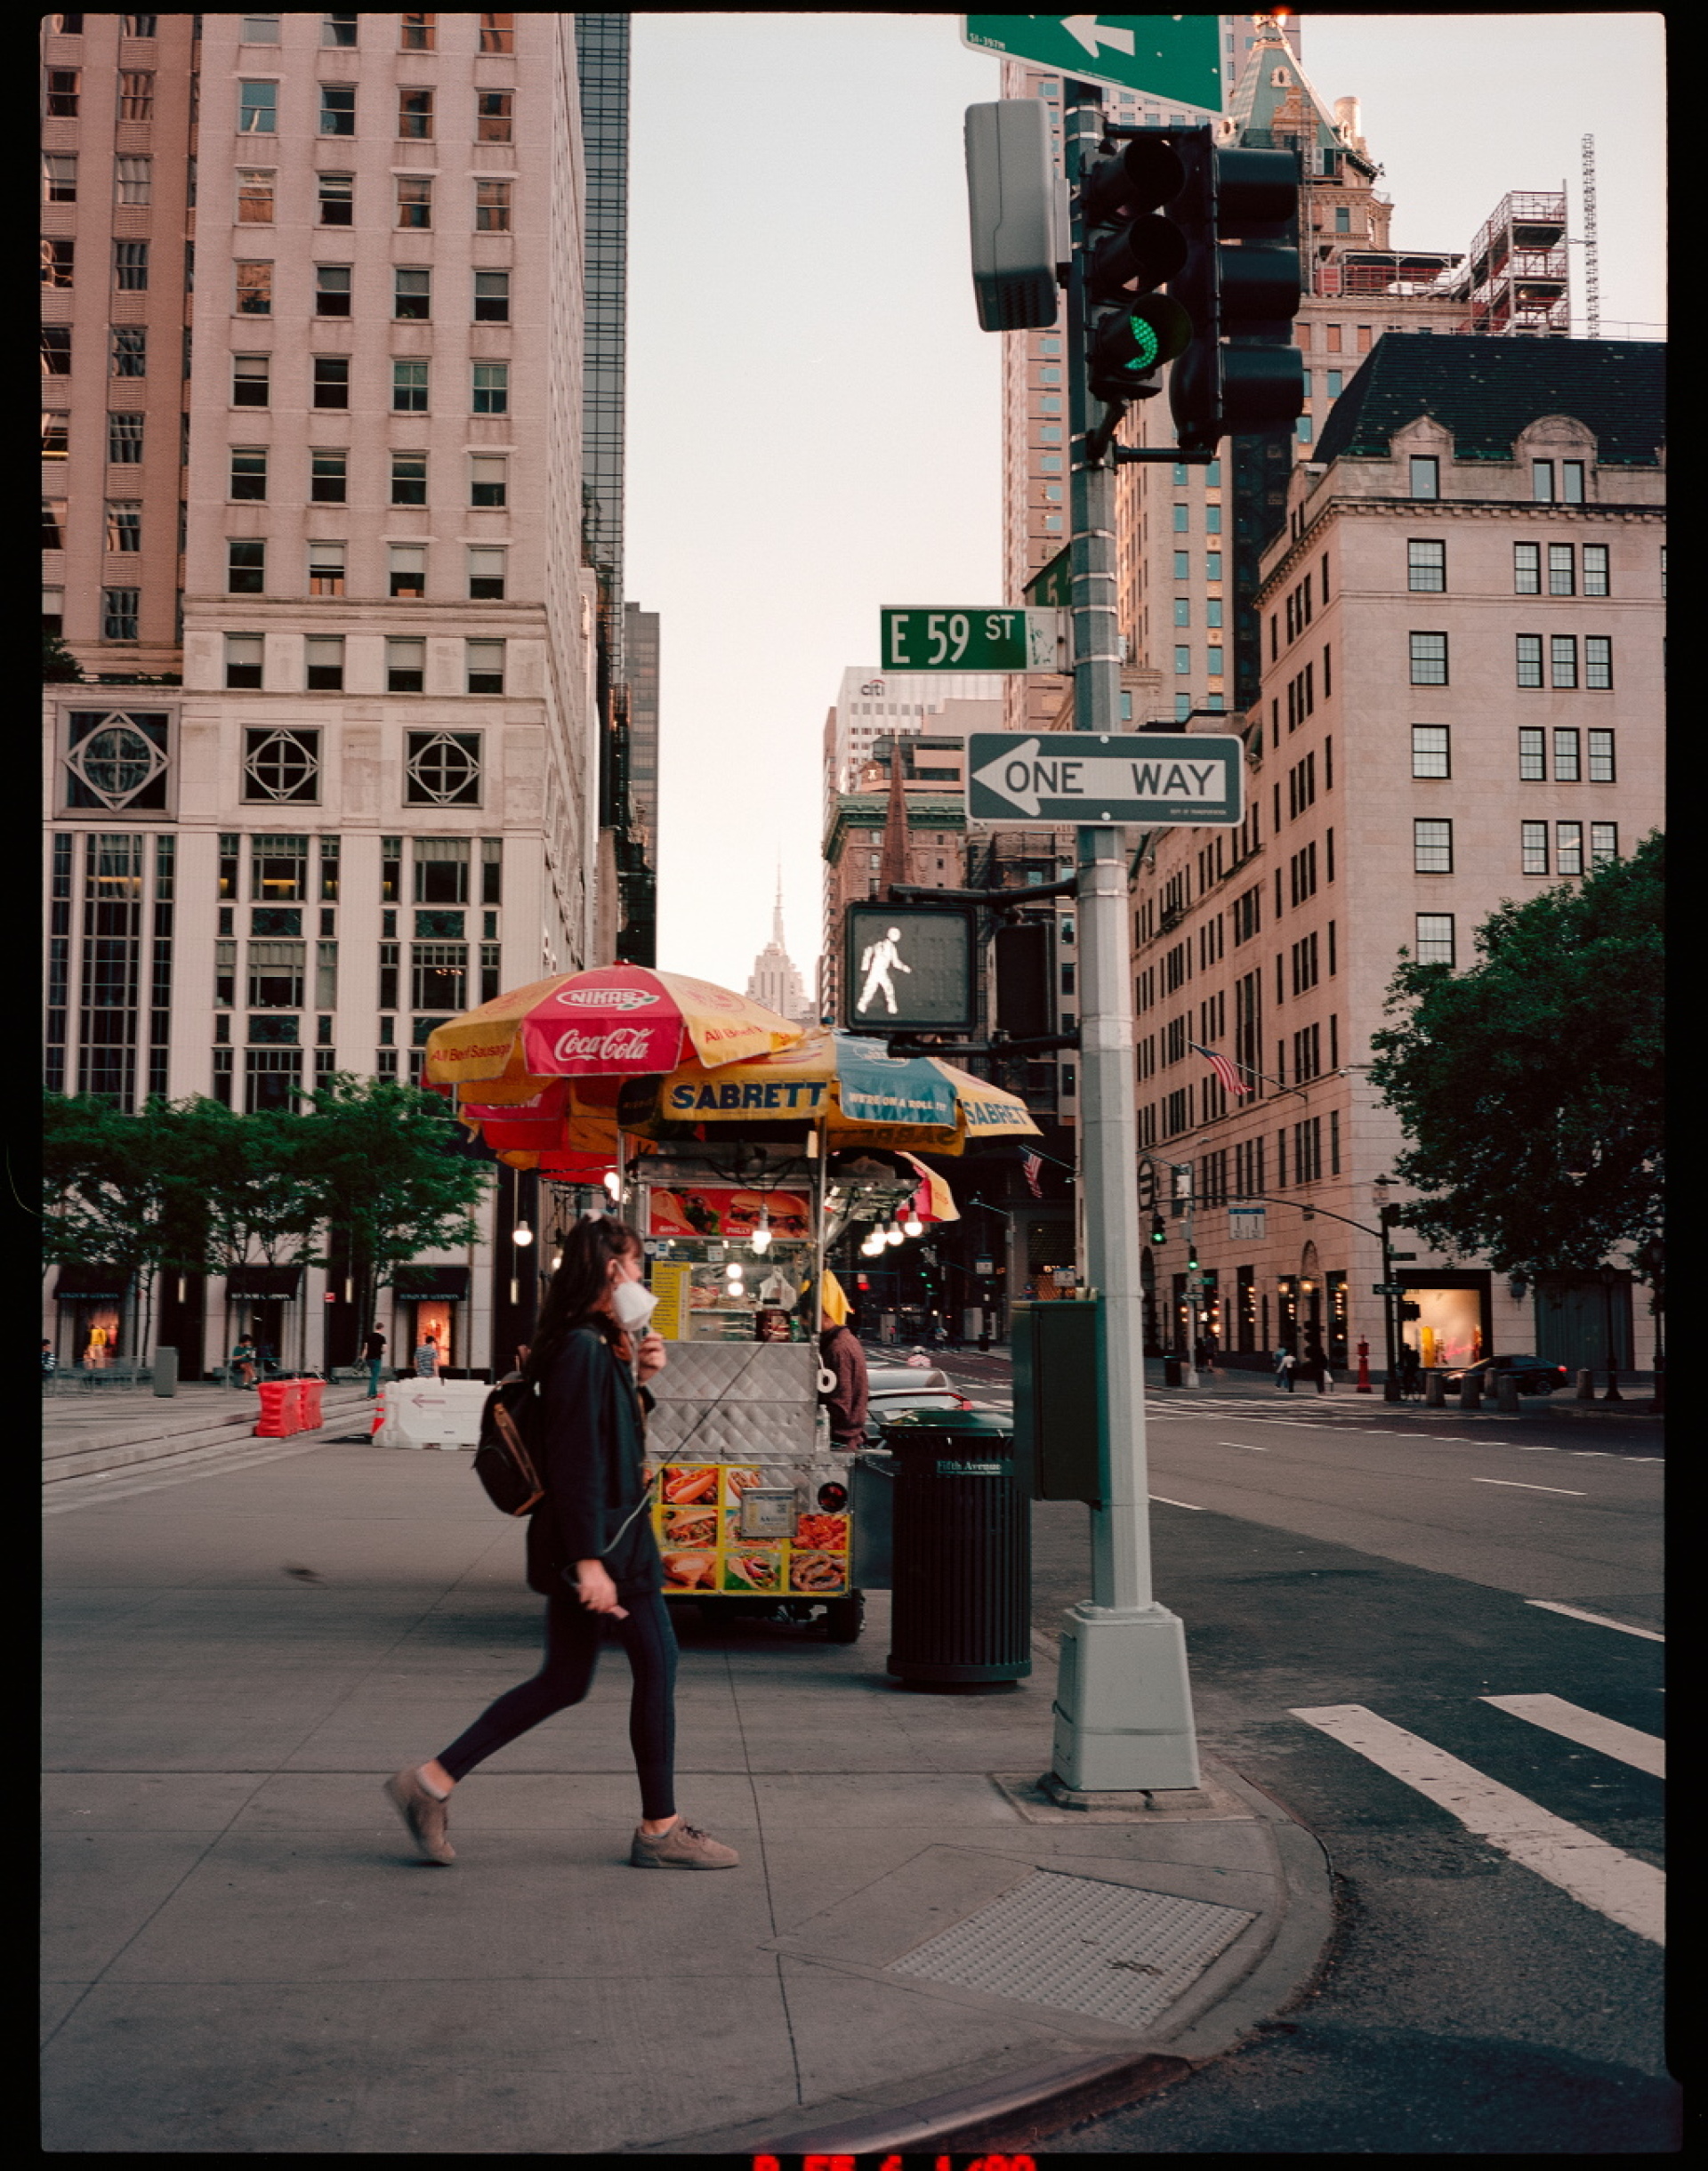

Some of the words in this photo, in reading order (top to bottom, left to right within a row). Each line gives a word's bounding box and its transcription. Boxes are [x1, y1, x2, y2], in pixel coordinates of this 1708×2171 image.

[890, 614, 910, 664] E
[928, 614, 970, 666] 59
[986, 614, 1016, 641] ST
[861, 679, 885, 697] citi
[1005, 761, 1084, 795] ONE
[1132, 763, 1216, 796] WAY
[570, 990, 637, 1005] NIKAS
[431, 1048, 448, 1061] All
[554, 1028, 655, 1061] Coca-Cola
[671, 1080, 827, 1110] SABRETT
[937, 1460, 963, 1470] Fifth
[964, 1460, 1003, 1471] Avenue
